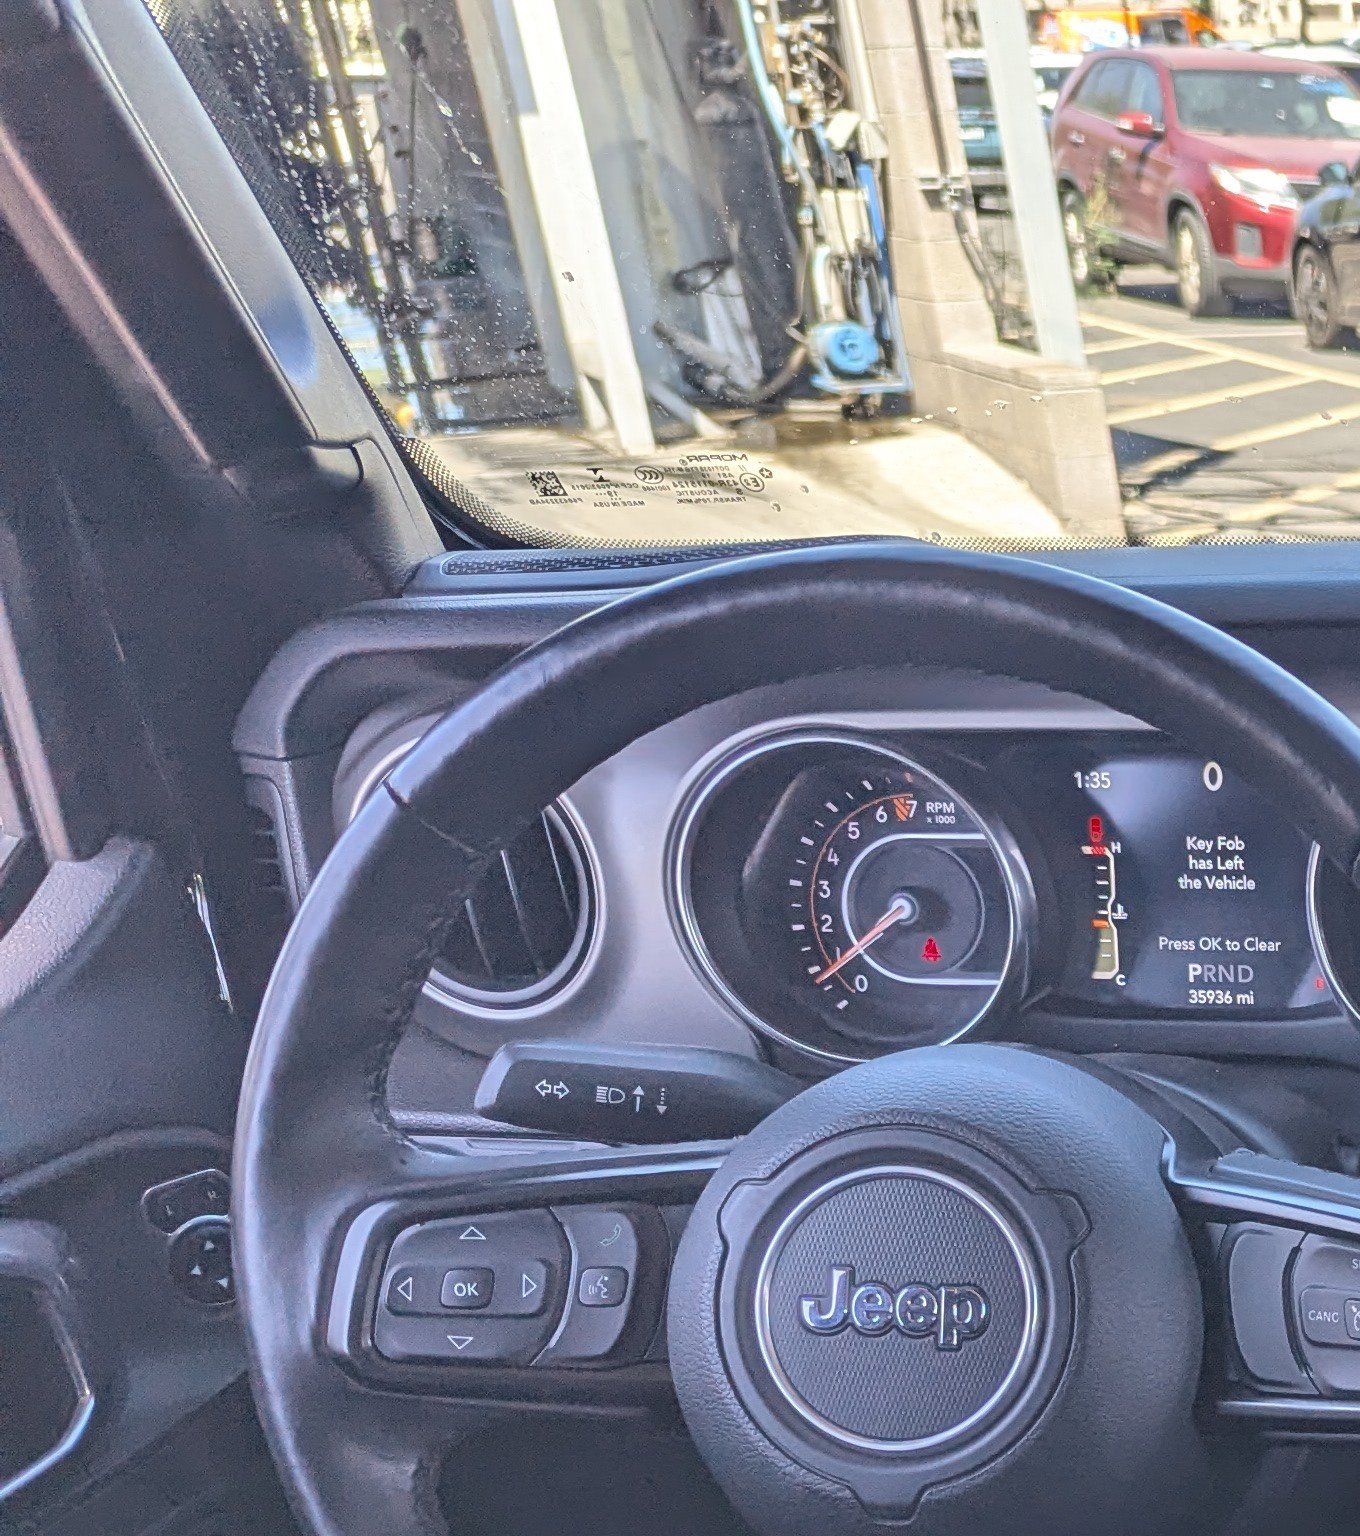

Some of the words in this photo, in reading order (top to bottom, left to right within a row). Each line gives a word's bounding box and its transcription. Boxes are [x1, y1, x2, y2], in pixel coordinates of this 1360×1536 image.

[1073, 771, 1111, 789] 1:35
[1203, 760, 1224, 792] 0
[875, 805, 888, 824] 6
[905, 799, 918, 818] 7
[926, 802, 956, 814] RPM
[847, 822, 860, 840] 5
[1110, 841, 1122, 854] H
[1186, 836, 1213, 854] Key
[1217, 836, 1245, 852] Fob
[826, 848, 840, 866] 4
[1189, 855, 1213, 871] has
[1216, 855, 1245, 871] Left
[818, 880, 831, 899] 3
[1178, 875, 1202, 890] the
[1205, 875, 1256, 891] Vehicle
[821, 914, 833, 933] 2
[1158, 935, 1195, 952] Press
[1199, 936, 1222, 951] OK
[1225, 938, 1241, 951] to
[1244, 936, 1281, 952] Clear
[855, 974, 869, 993] 0
[1115, 974, 1126, 987] C
[1188, 990, 1233, 1005] 35936
[1236, 990, 1255, 1005] mi
[453, 1281, 480, 1298] OK
[798, 1263, 993, 1352] Jeep
[1308, 1309, 1340, 1324] CANC
